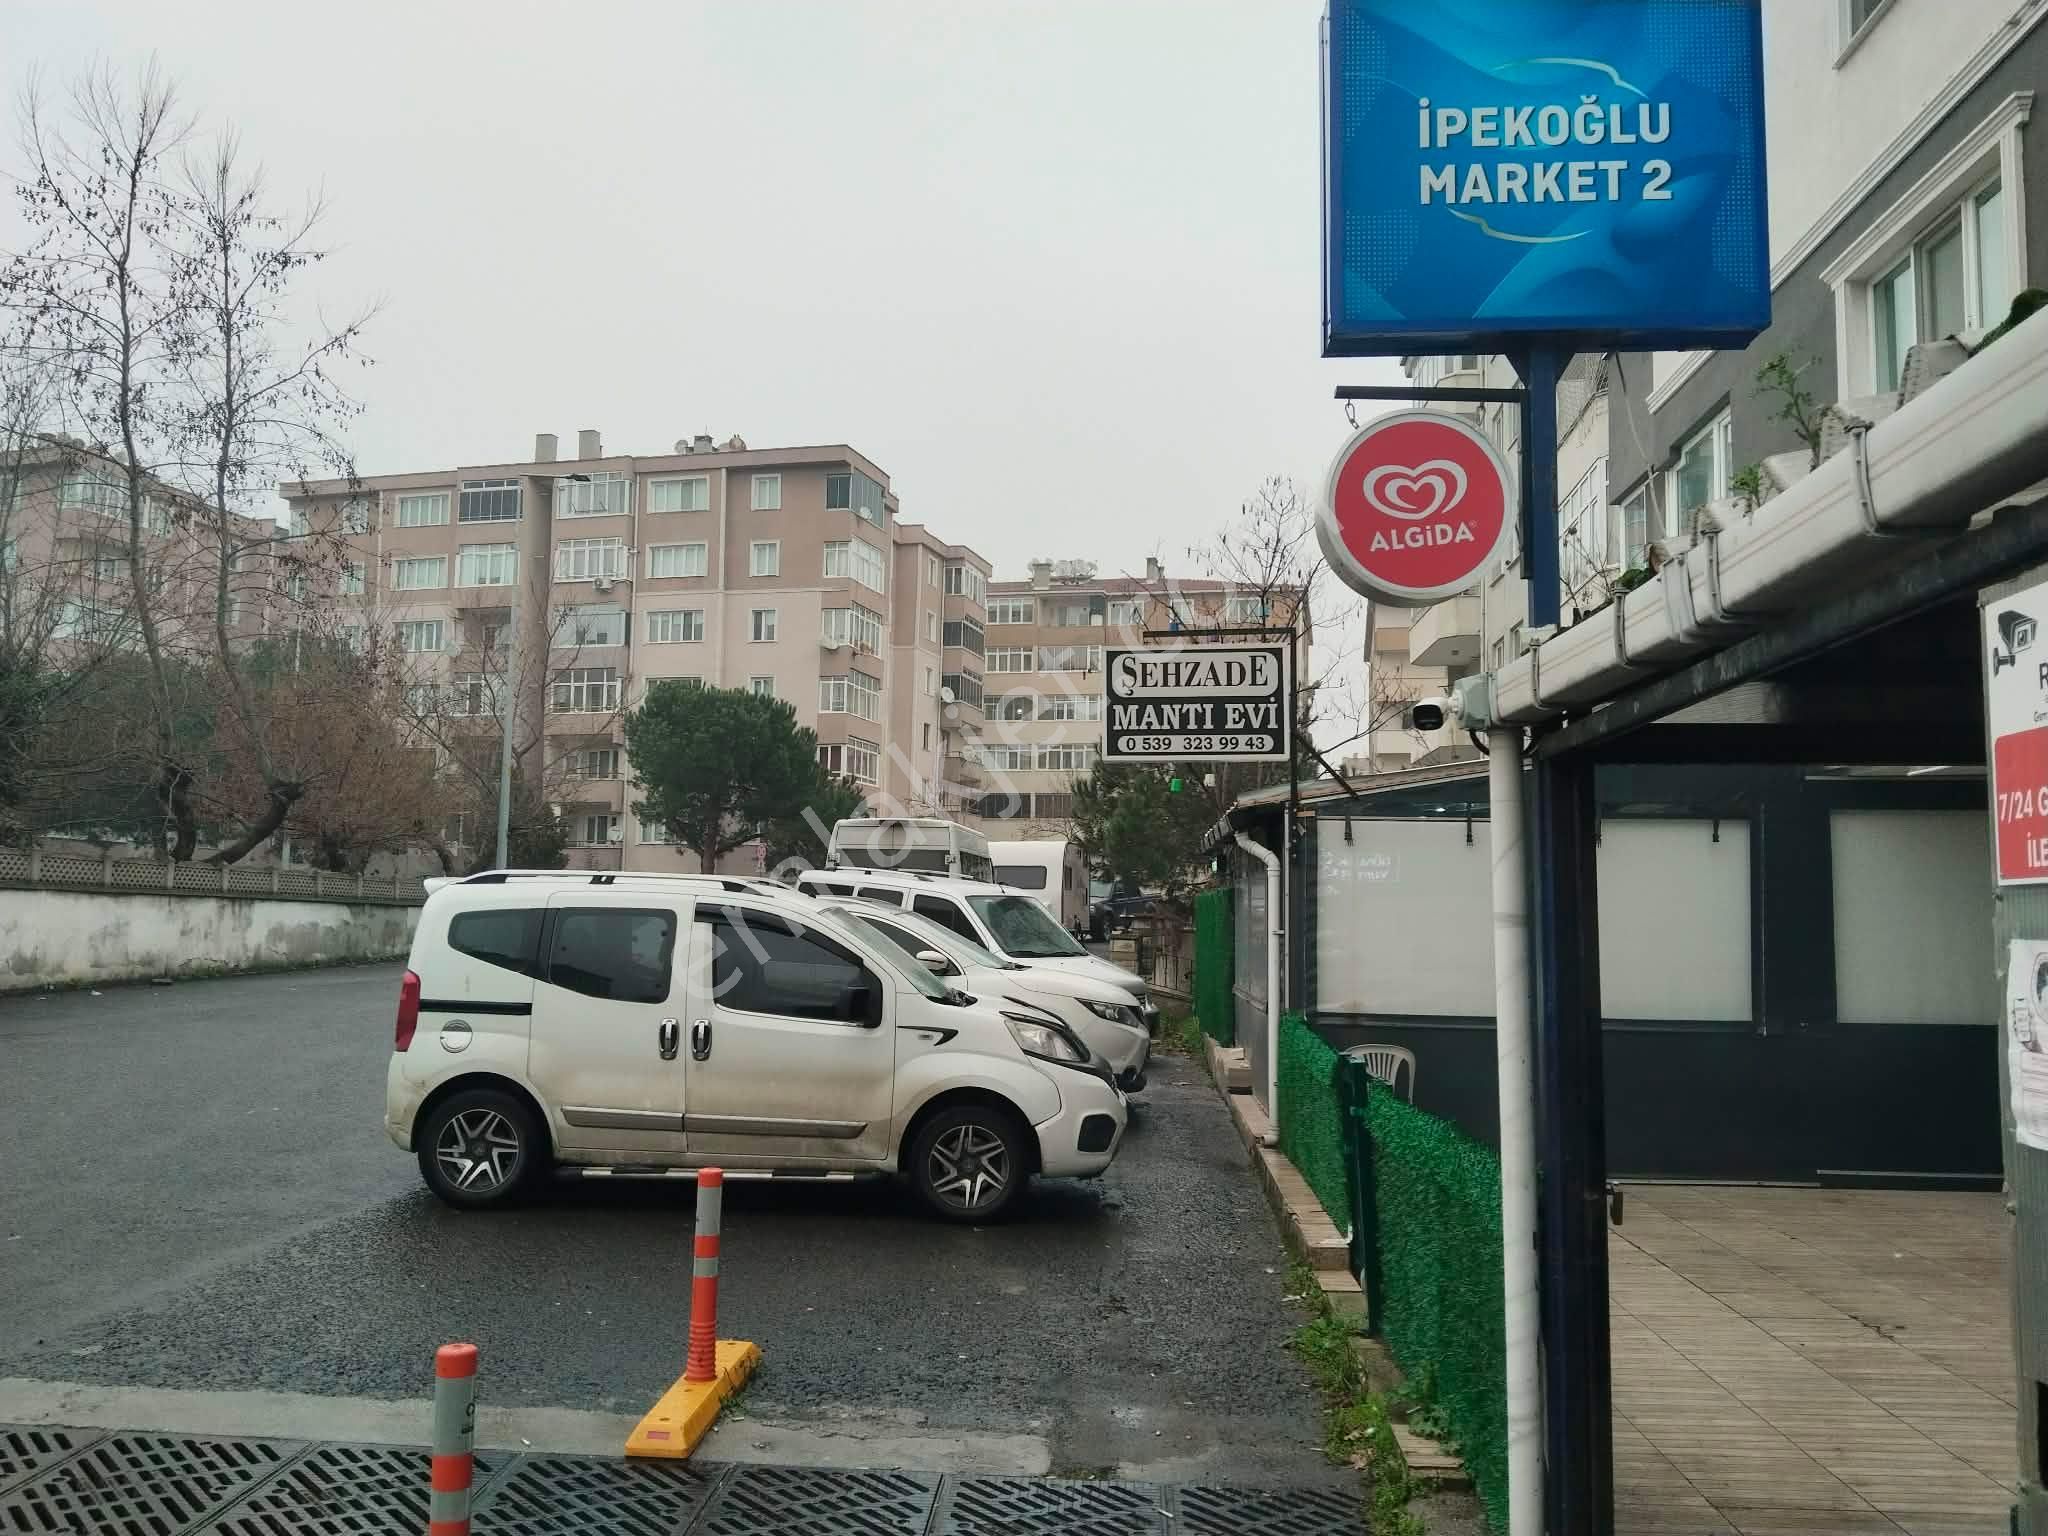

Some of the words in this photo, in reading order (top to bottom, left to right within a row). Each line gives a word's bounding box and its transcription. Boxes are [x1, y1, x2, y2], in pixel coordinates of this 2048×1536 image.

[1418, 94, 1671, 149] İPEKOĞLU
[1419, 160, 1628, 205] MARKET
[1642, 159, 1673, 201] 2
[1121, 655, 1269, 696] ŞEHZADE
[1112, 703, 1214, 731] MANTI
[1224, 696, 1279, 730] EVİ
[1126, 737, 1137, 751] 0
[1142, 737, 1172, 751] 539
[1183, 737, 1214, 751] 323
[1219, 737, 1240, 751] 99
[1244, 737, 1266, 750] 43
[1999, 788, 2033, 824] 7/24
